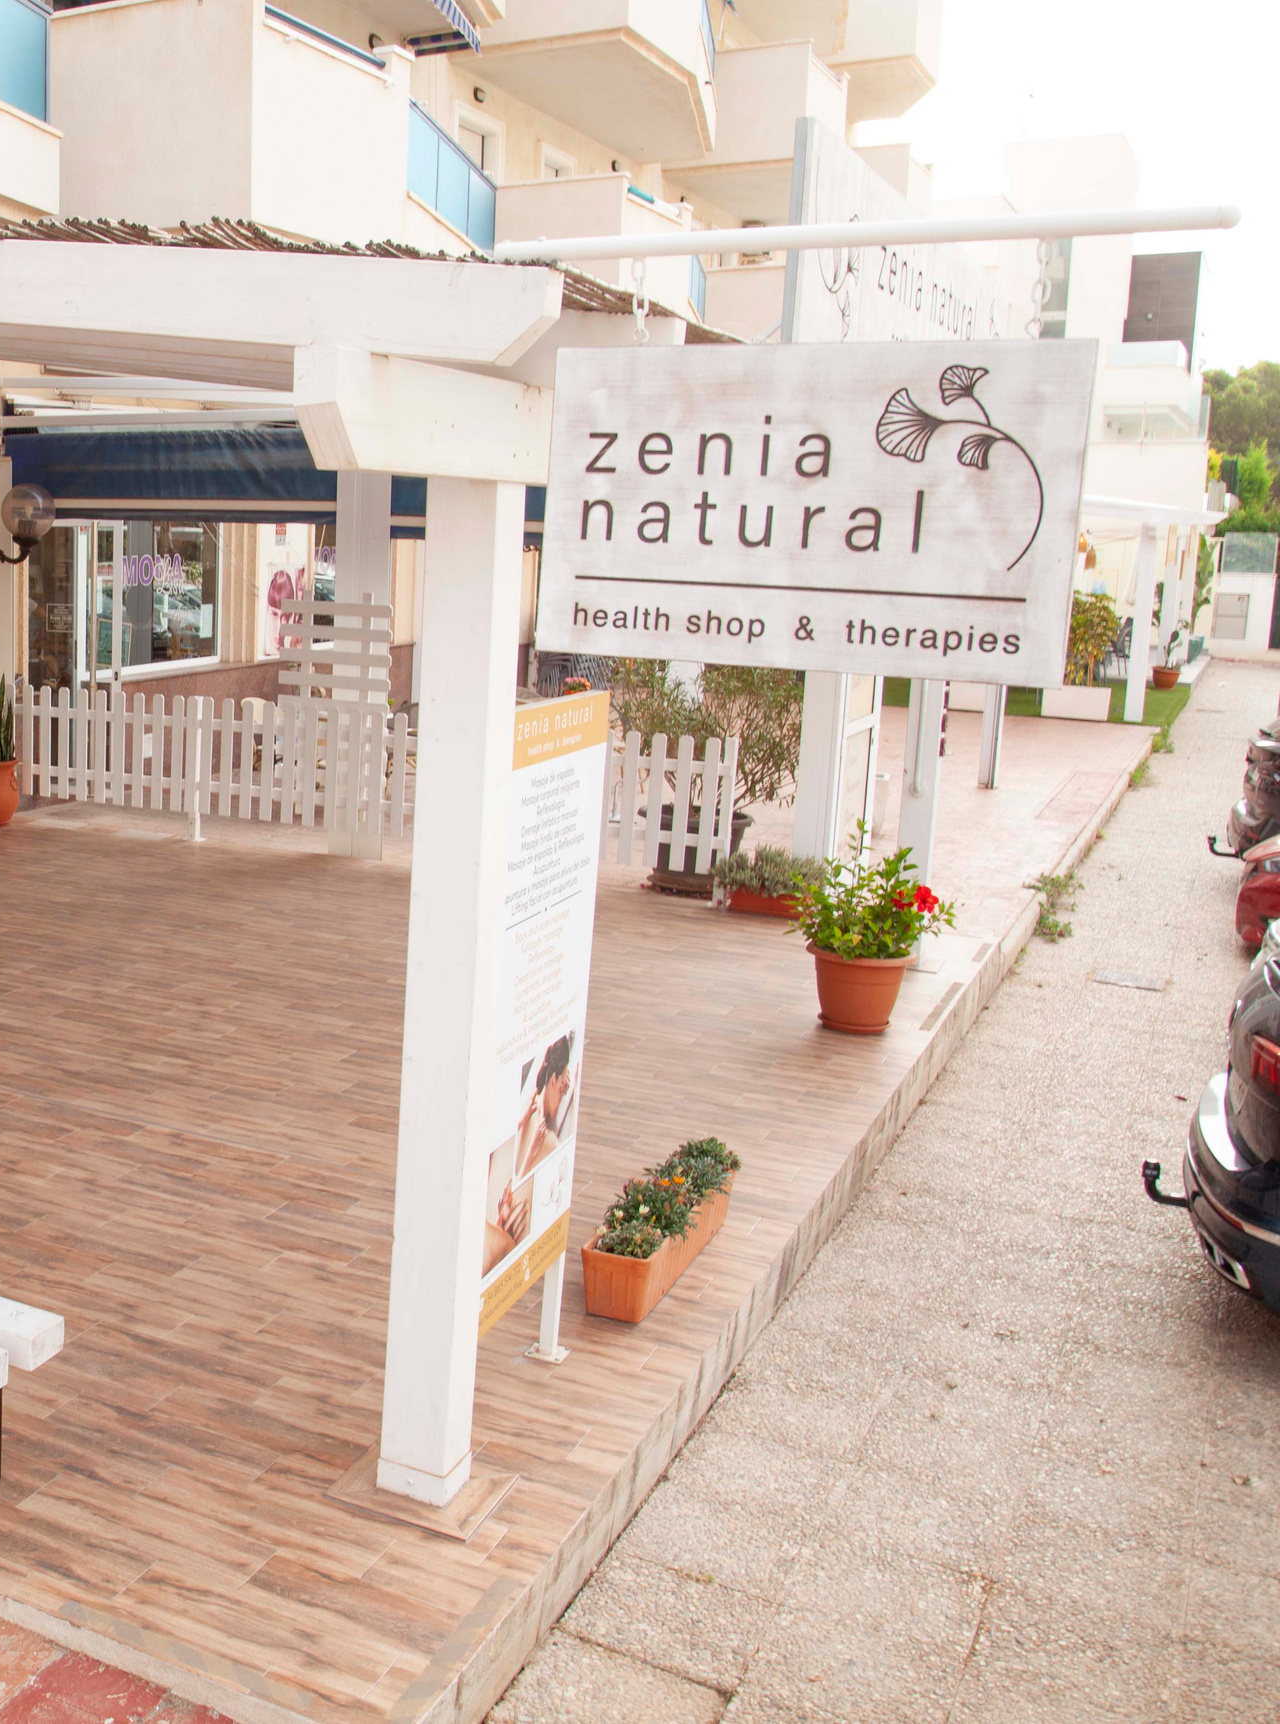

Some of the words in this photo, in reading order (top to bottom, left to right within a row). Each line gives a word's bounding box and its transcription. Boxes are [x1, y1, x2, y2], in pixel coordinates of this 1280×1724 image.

[930, 283, 978, 341] natural
[585, 414, 832, 479] zenia
[579, 489, 924, 554] natural
[123, 553, 181, 587] MONA
[573, 601, 670, 632] health
[685, 609, 766, 644] shop
[793, 616, 815, 641] &
[845, 618, 1021, 656] therapies
[518, 713, 549, 740] zenia
[555, 700, 594, 730] natural
[521, 794, 538, 806] Masaje
[540, 786, 558, 800] corporal
[560, 780, 579, 793] relajante
[531, 776, 548, 788] Masaje
[550, 773, 555, 782] de
[557, 767, 574, 780] espalda
[521, 823, 540, 836] Drenaje
[561, 807, 577, 821] manual
[521, 838, 538, 851] Masaje
[554, 830, 559, 838] de
[560, 824, 575, 835] cabeza
[507, 858, 525, 871] Masaje
[527, 855, 532, 863] de
[534, 846, 552, 860] espalda
[531, 877, 547, 890] masaje
[549, 873, 559, 884] para
[561, 865, 571, 876] alivio
[580, 858, 590, 867] dolor
[533, 858, 560, 875] Acupuntura
[511, 902, 527, 915] Lifting
[529, 893, 541, 906] facial
[552, 878, 577, 894] acupuntura
